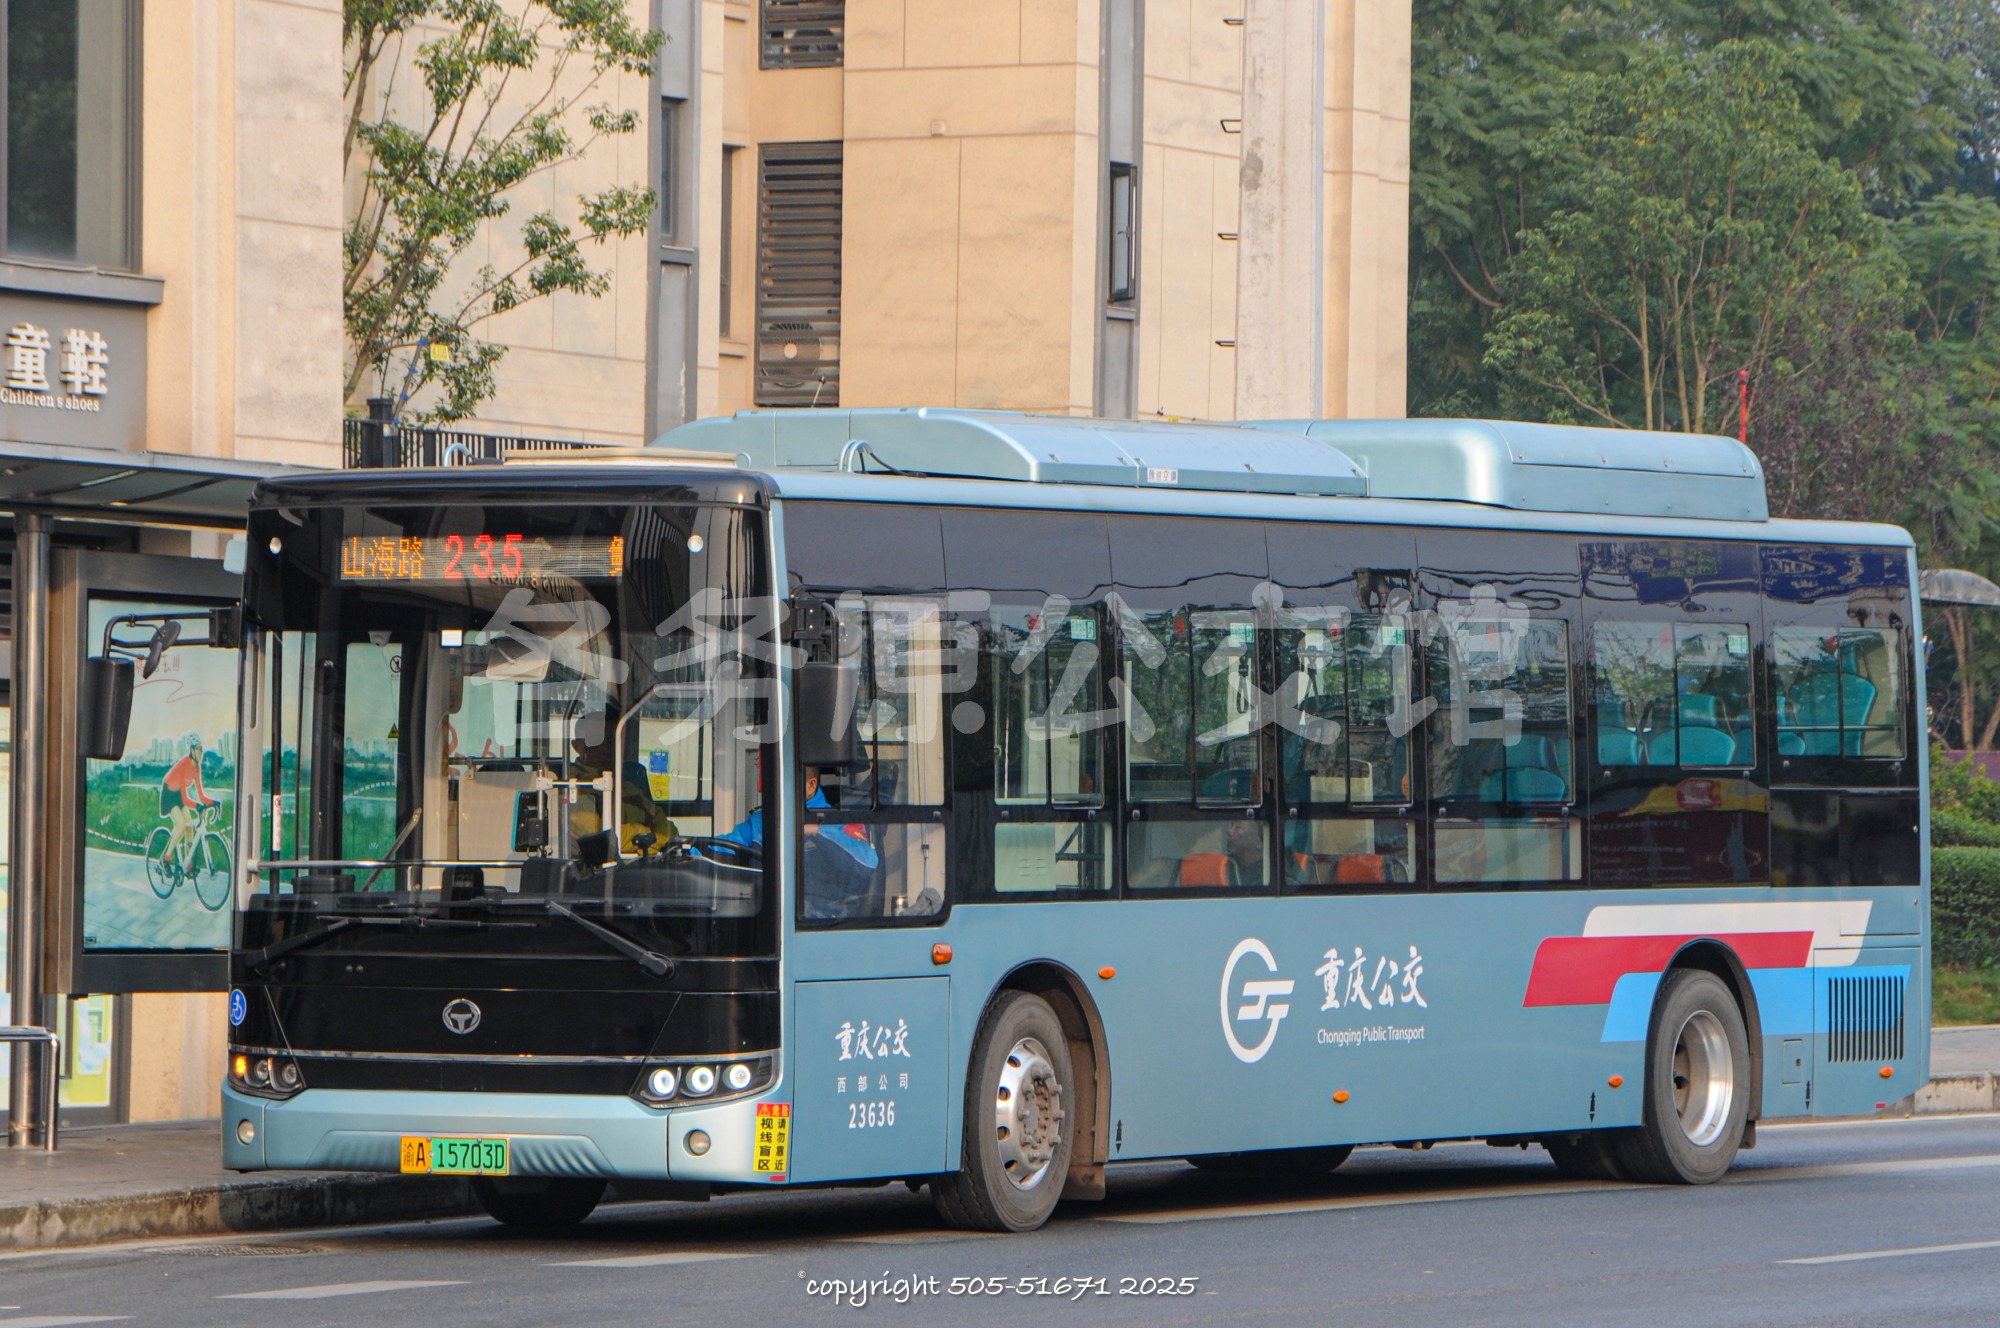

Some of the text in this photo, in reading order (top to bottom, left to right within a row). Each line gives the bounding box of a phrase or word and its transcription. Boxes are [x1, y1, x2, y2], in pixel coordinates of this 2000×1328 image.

[4, 322, 109, 395] 童鞋
[66, 395, 100, 412] shoes
[343, 534, 523, 579] 山海路 235
[1314, 945, 1428, 1012] 重庆公交
[834, 1018, 911, 1061] 重庆公交
[1317, 1026, 1425, 1047] Chongqing Public Transport
[837, 1072, 909, 1094] 西部公司
[848, 1101, 896, 1129] 23636
[758, 1117, 773, 1170] 视线盲区
[775, 1118, 786, 1170] 请勿靠近
